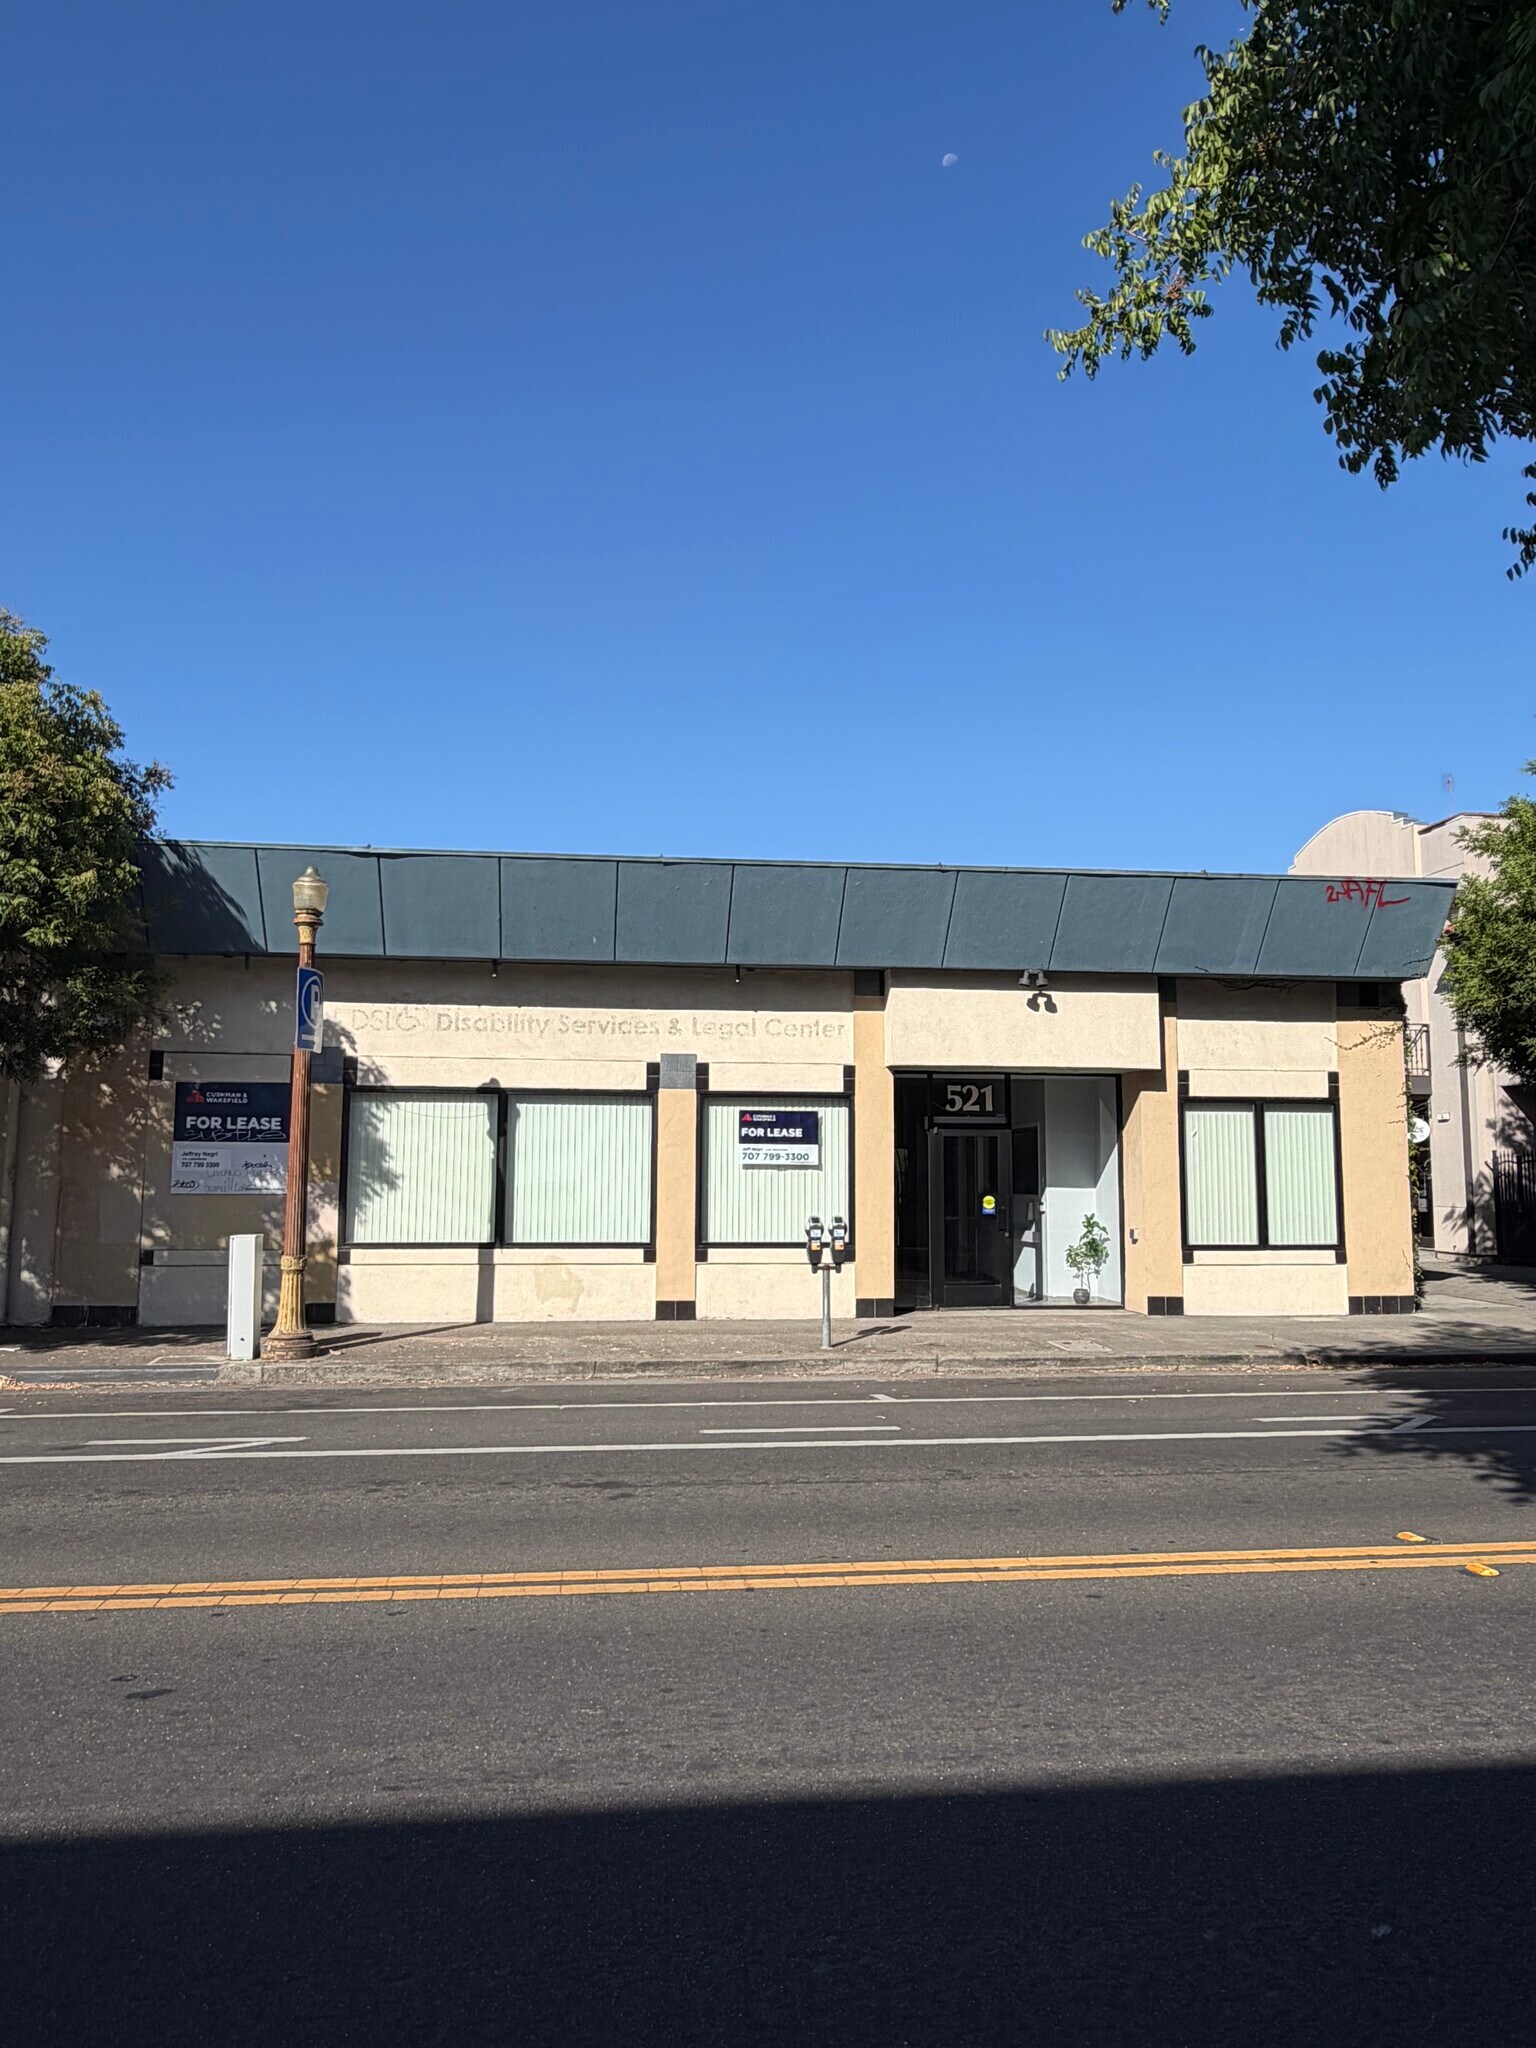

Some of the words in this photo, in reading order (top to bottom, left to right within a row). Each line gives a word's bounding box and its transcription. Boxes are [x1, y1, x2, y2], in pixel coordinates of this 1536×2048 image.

[436, 1012, 550, 1038] Disability
[558, 1013, 660, 1036] Services
[668, 1017, 683, 1037] &
[692, 1017, 757, 1041] Legal
[765, 1018, 846, 1038] Center
[945, 1084, 993, 1112] 521
[186, 1116, 222, 1129] FOR
[226, 1116, 282, 1130] LEASE
[741, 1127, 765, 1137] FOR
[767, 1128, 803, 1138] LEASE
[742, 1152, 761, 1161] 707
[763, 1152, 809, 1161] 799-3300
